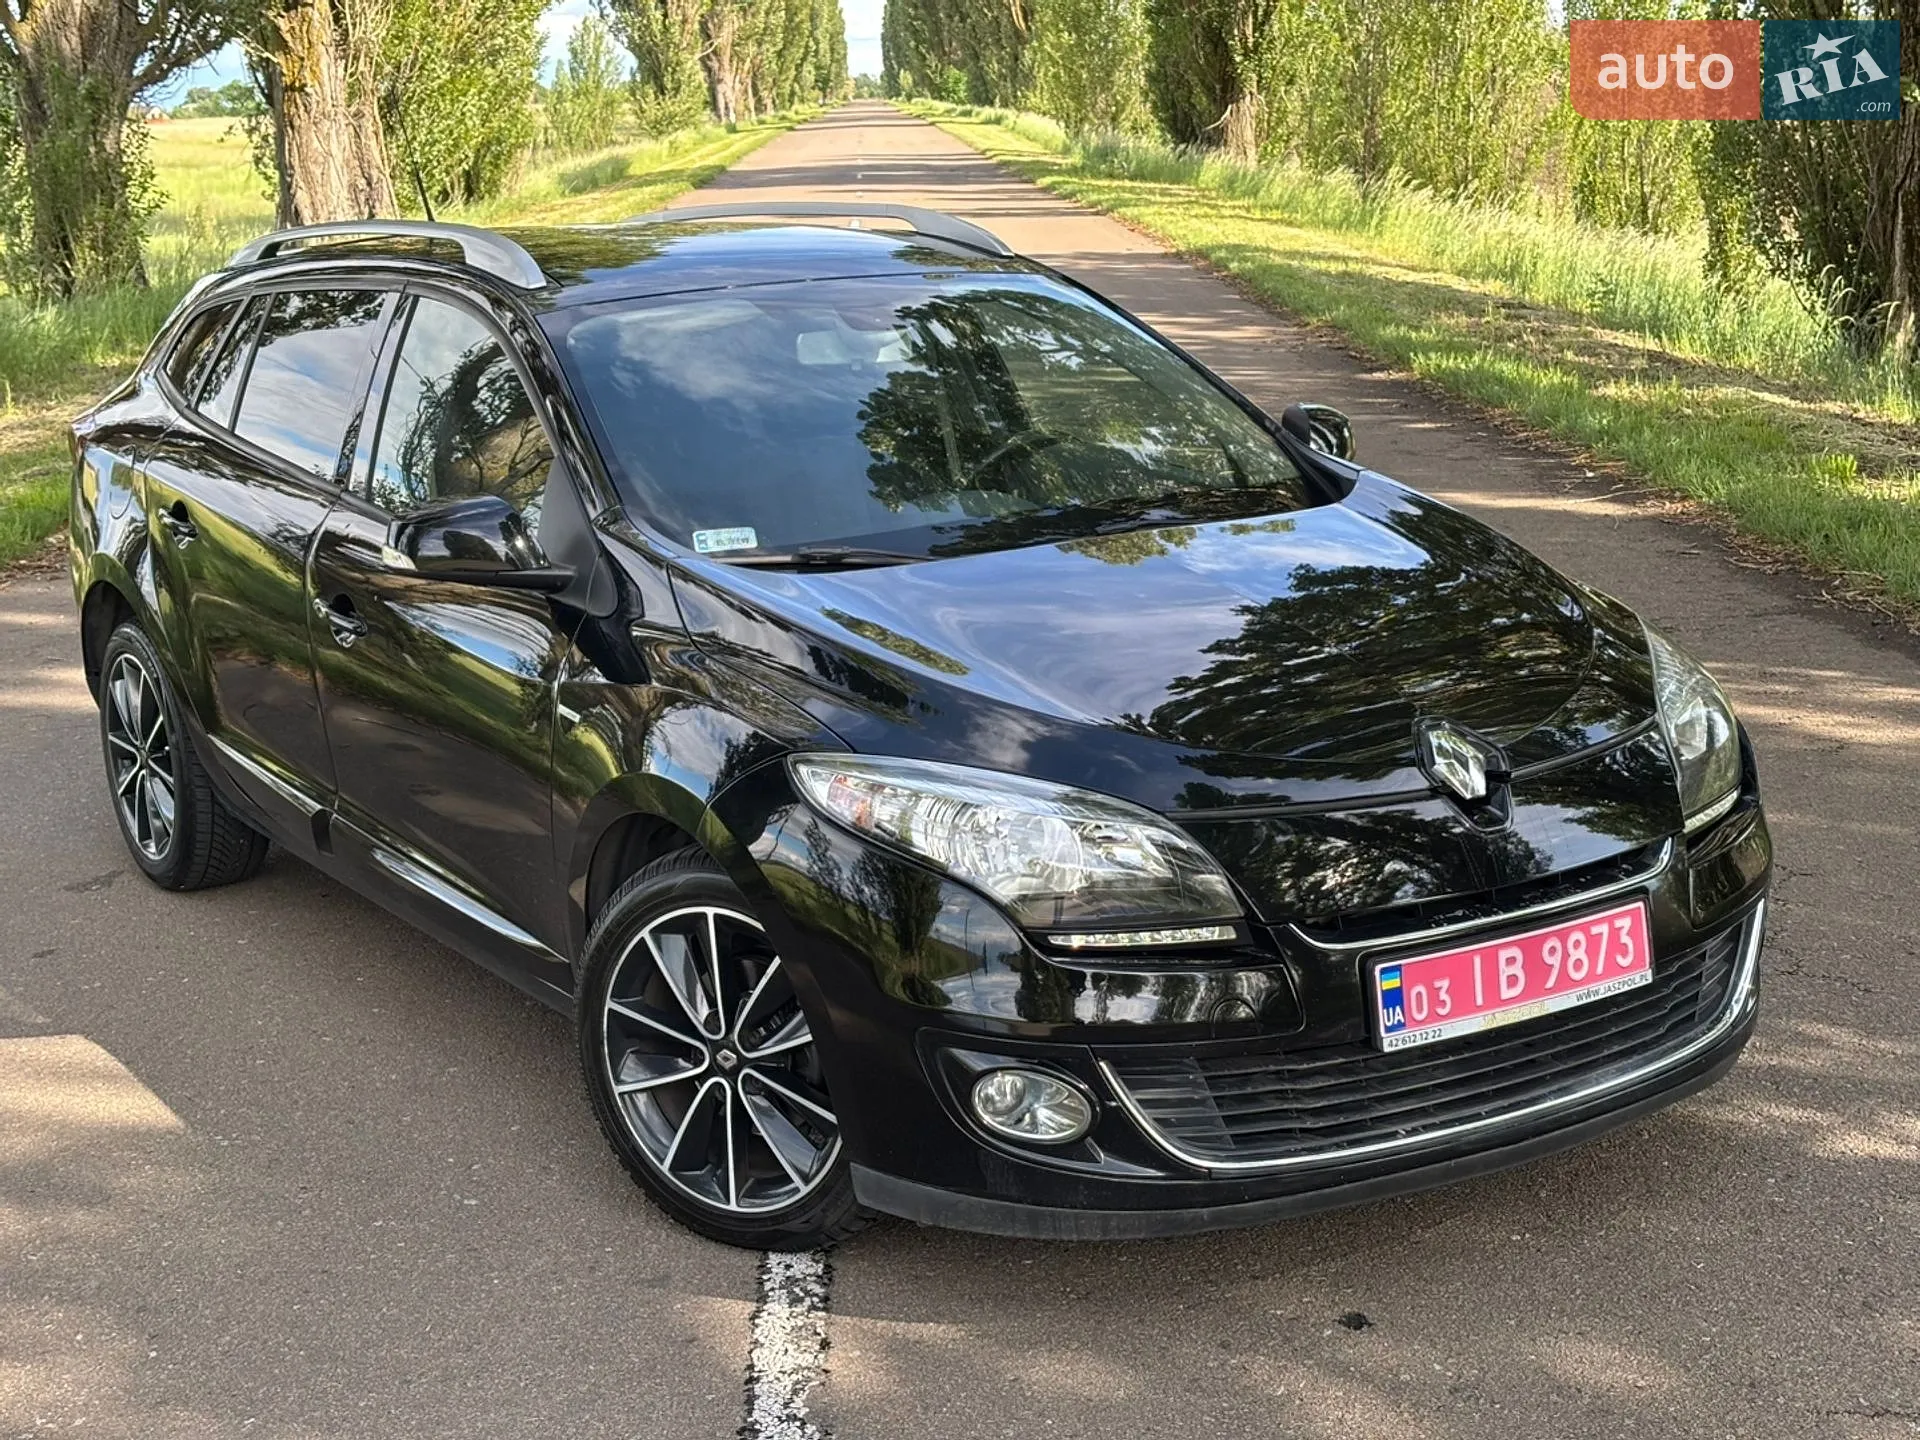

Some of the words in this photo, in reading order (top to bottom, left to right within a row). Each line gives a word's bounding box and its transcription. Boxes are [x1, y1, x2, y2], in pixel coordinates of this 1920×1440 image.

[1409, 976, 1452, 1022] 03
[1472, 946, 1526, 1007] IB
[1541, 915, 1635, 990] 9873
[1383, 1004, 1405, 1027] UA
